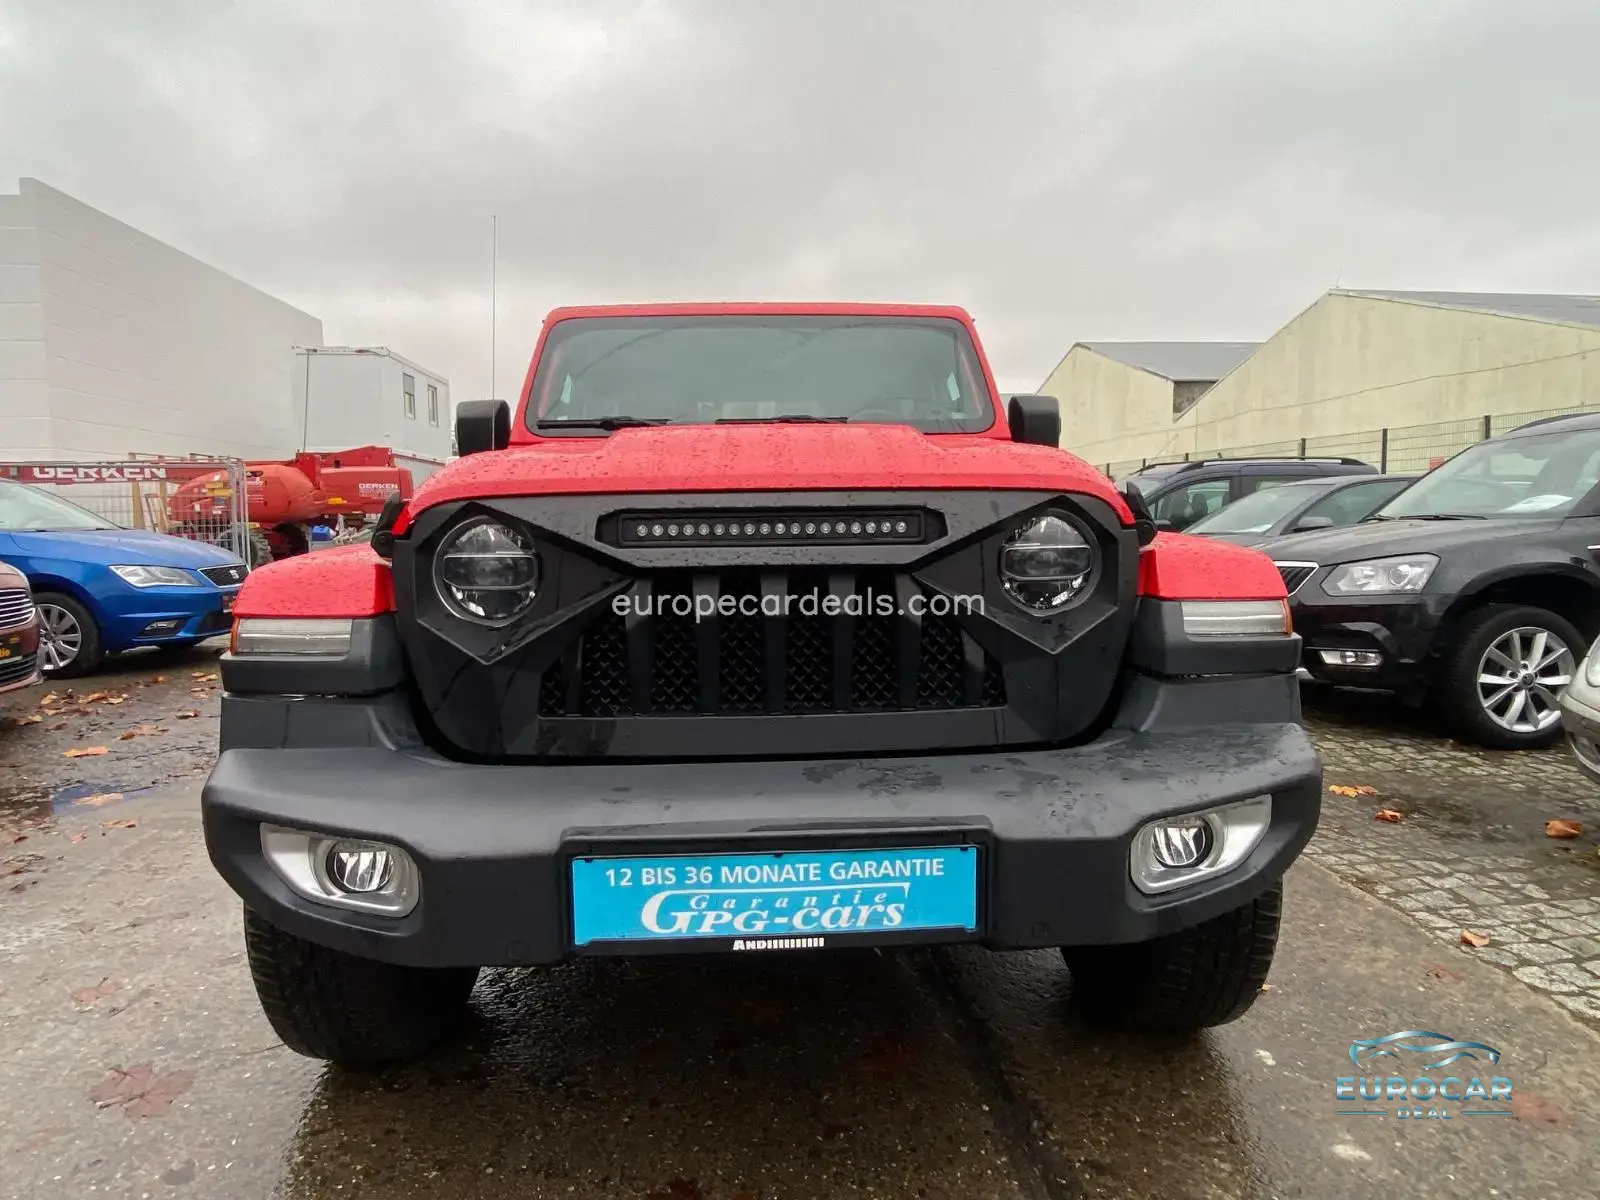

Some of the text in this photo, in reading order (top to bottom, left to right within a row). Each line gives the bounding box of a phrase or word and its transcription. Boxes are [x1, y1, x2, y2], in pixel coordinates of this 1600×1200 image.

[32, 464, 167, 481] GERKEN
[605, 857, 945, 887] 12 BIS 36 MONATE GARANTIE
[690, 889, 888, 910] Garantie
